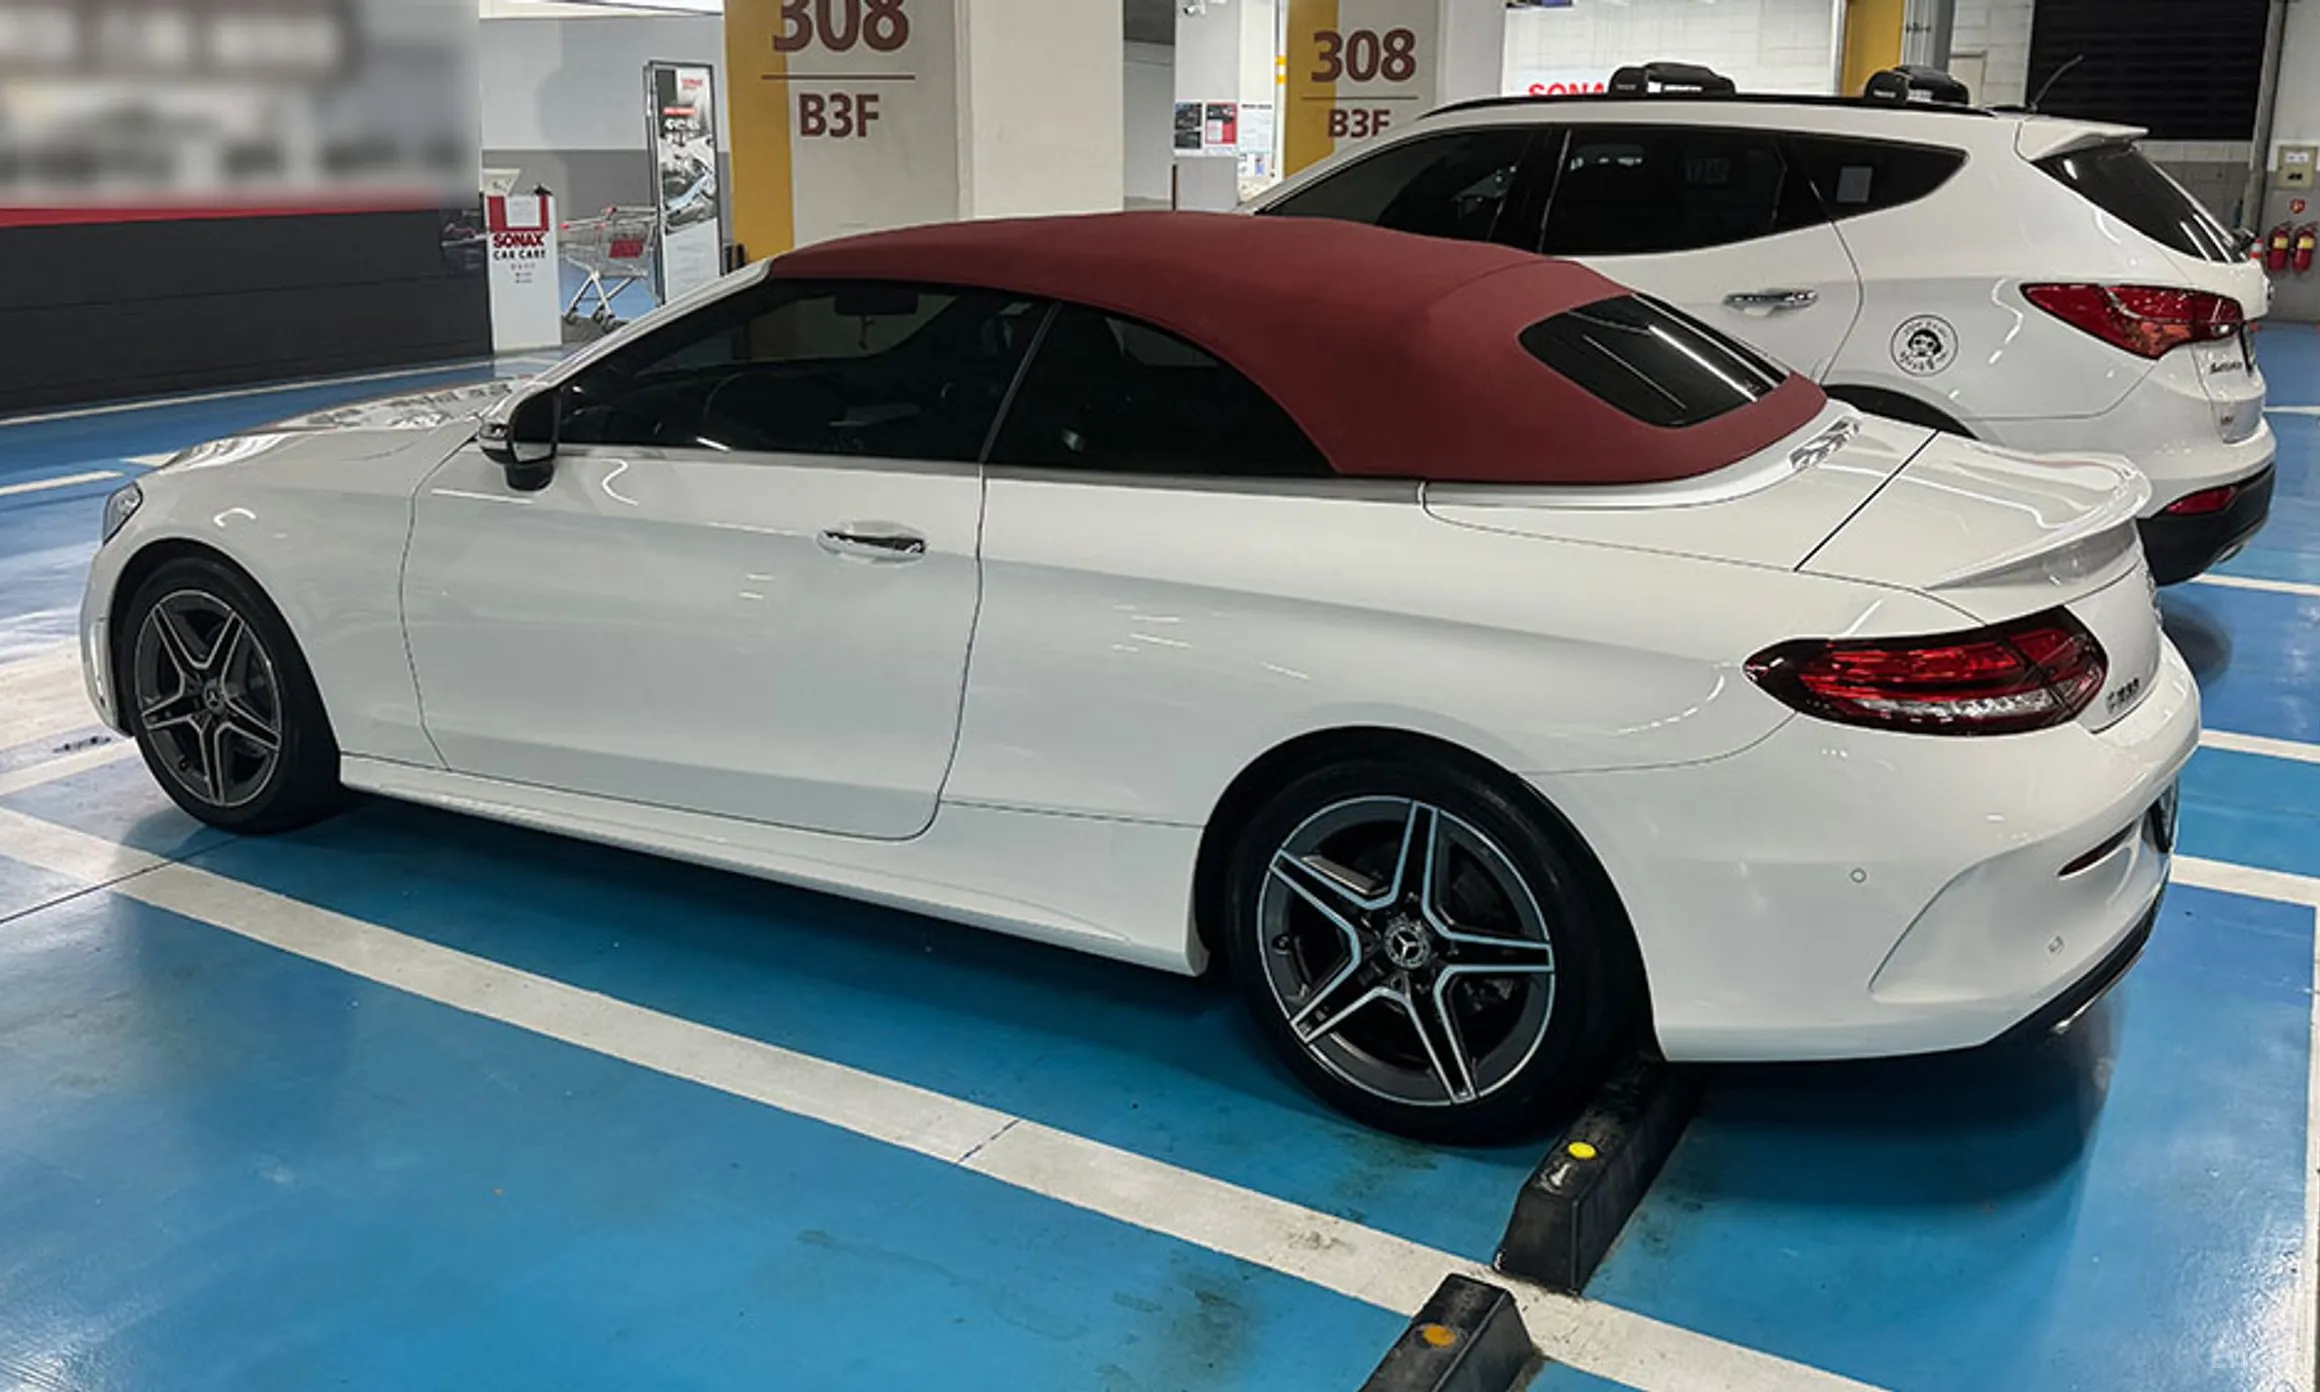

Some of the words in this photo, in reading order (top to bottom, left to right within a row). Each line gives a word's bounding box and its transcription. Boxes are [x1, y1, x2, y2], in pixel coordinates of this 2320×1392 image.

[772, 0, 909, 52] 308
[1311, 28, 1417, 82] 308
[1529, 82, 1605, 96] SONA
[799, 93, 880, 138] B3F
[1328, 108, 1390, 137] B3F
[493, 232, 546, 248] SONAX
